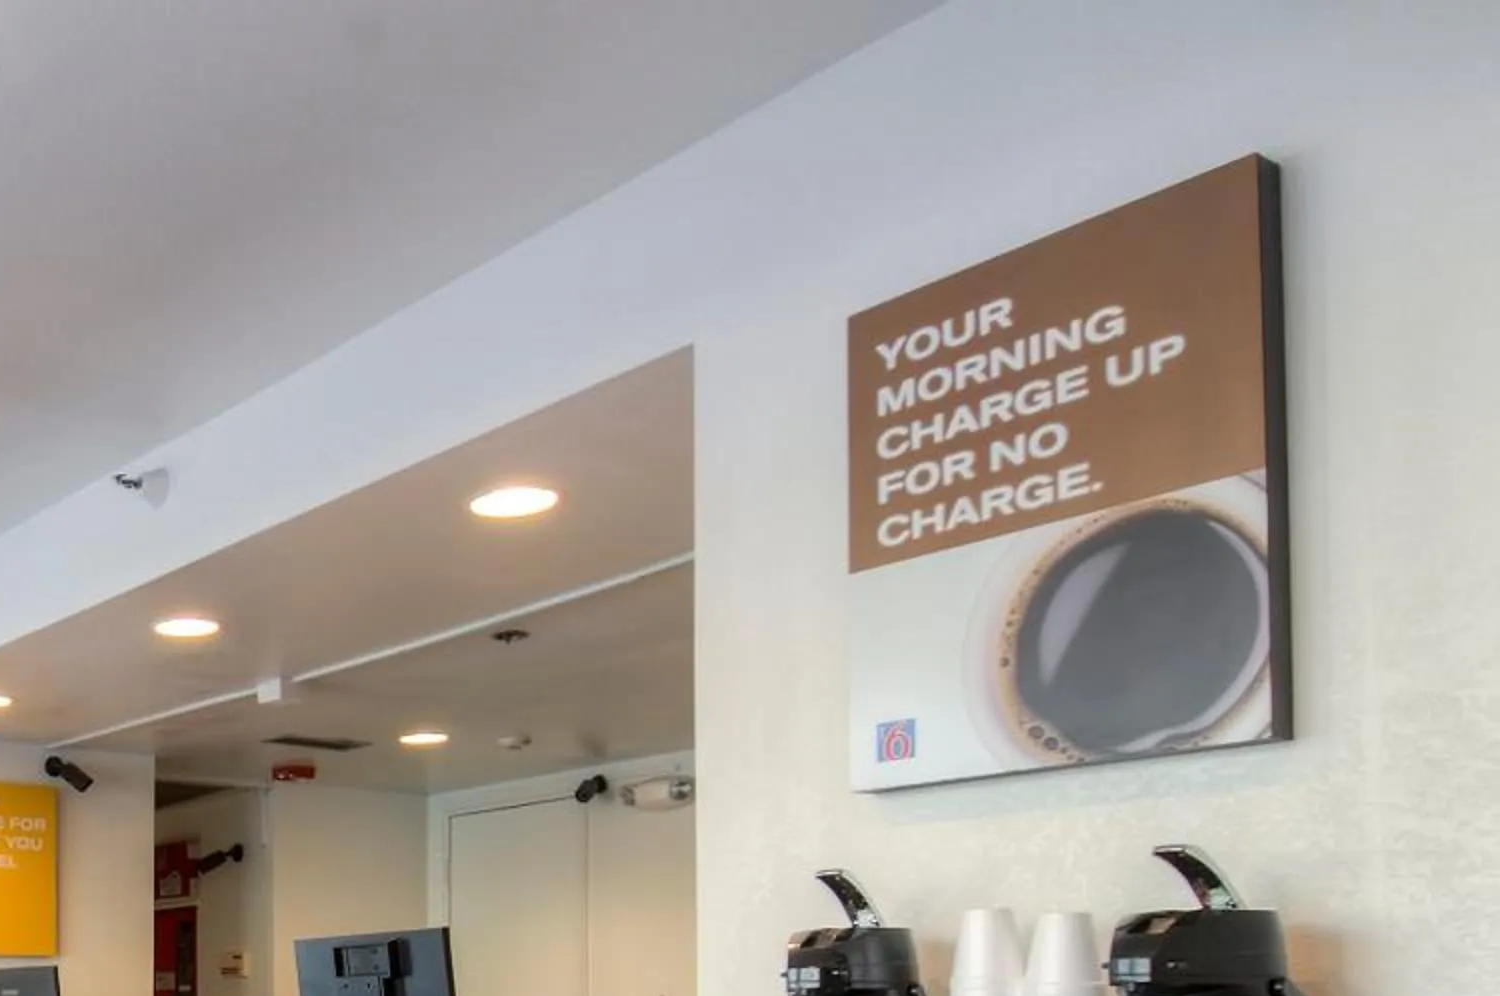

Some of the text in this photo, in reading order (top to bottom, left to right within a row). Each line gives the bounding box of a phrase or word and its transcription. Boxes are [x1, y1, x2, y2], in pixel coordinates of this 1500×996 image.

[875, 297, 1013, 371] YOUR
[877, 305, 1127, 417] MORNING
[876, 335, 1186, 459] CHARGE UP
[877, 462, 1104, 547] CHARGE.
[878, 423, 1069, 505] FOR NO
[6, 836, 44, 851] YOU
[9, 816, 47, 832] FOR
